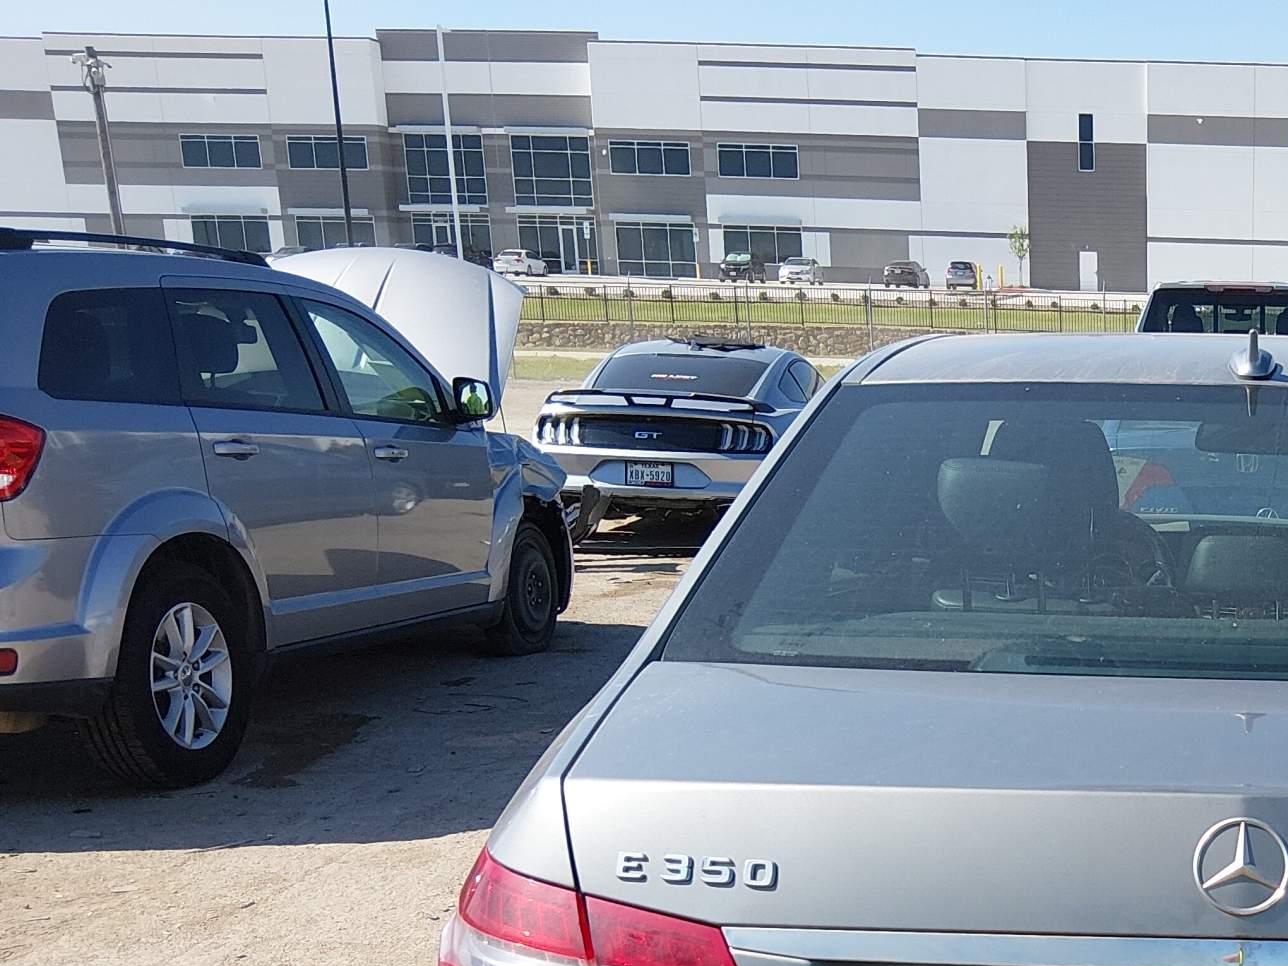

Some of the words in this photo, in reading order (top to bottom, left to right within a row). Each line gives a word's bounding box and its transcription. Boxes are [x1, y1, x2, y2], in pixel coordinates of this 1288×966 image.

[634, 431, 663, 439] GT
[616, 851, 649, 882] E
[660, 853, 779, 891] 350
